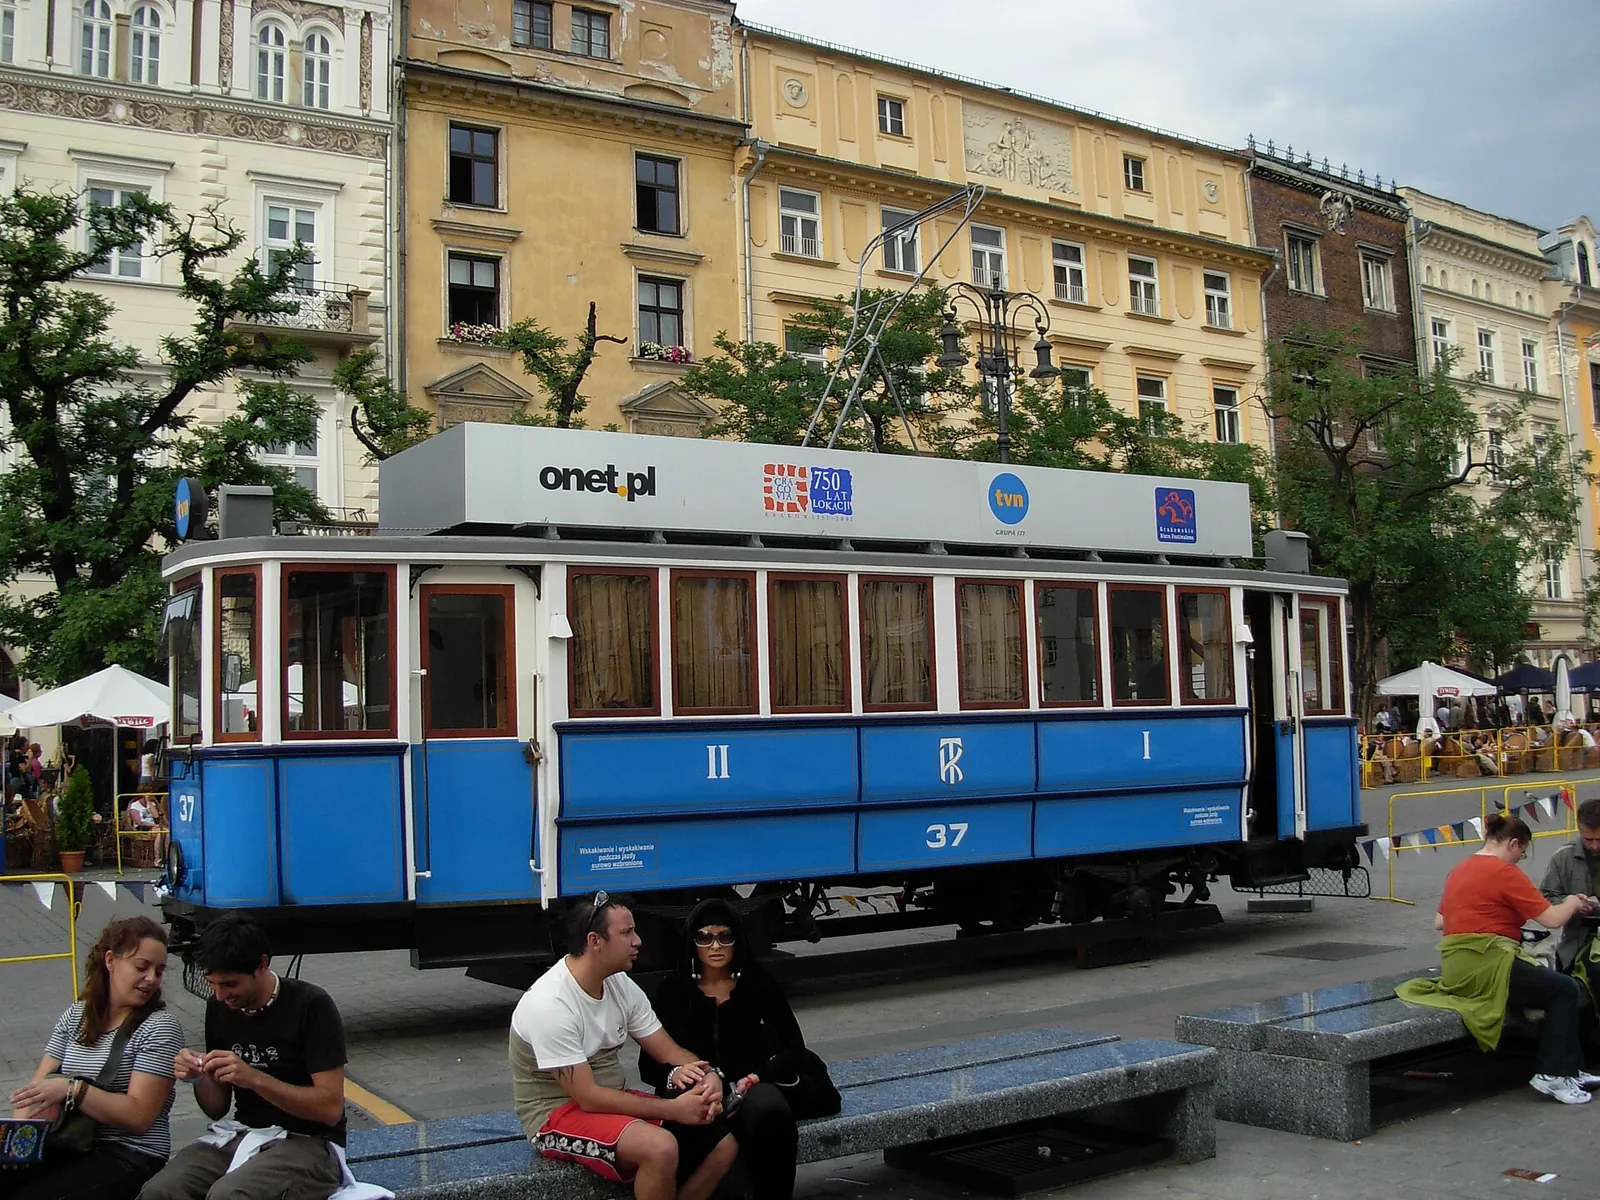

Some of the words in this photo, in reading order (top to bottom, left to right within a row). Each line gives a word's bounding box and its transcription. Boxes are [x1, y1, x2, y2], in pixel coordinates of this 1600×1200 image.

[539, 464, 656, 502] onet.pl
[814, 470, 840, 491] 750
[812, 499, 850, 512] LOKACJI
[826, 491, 848, 501] LAT
[995, 488, 1024, 507] tvn
[1142, 731, 1151, 760] I
[706, 745, 730, 779] II
[179, 795, 195, 822] 37
[926, 822, 969, 849] 37
[598, 853, 621, 862] podczas
